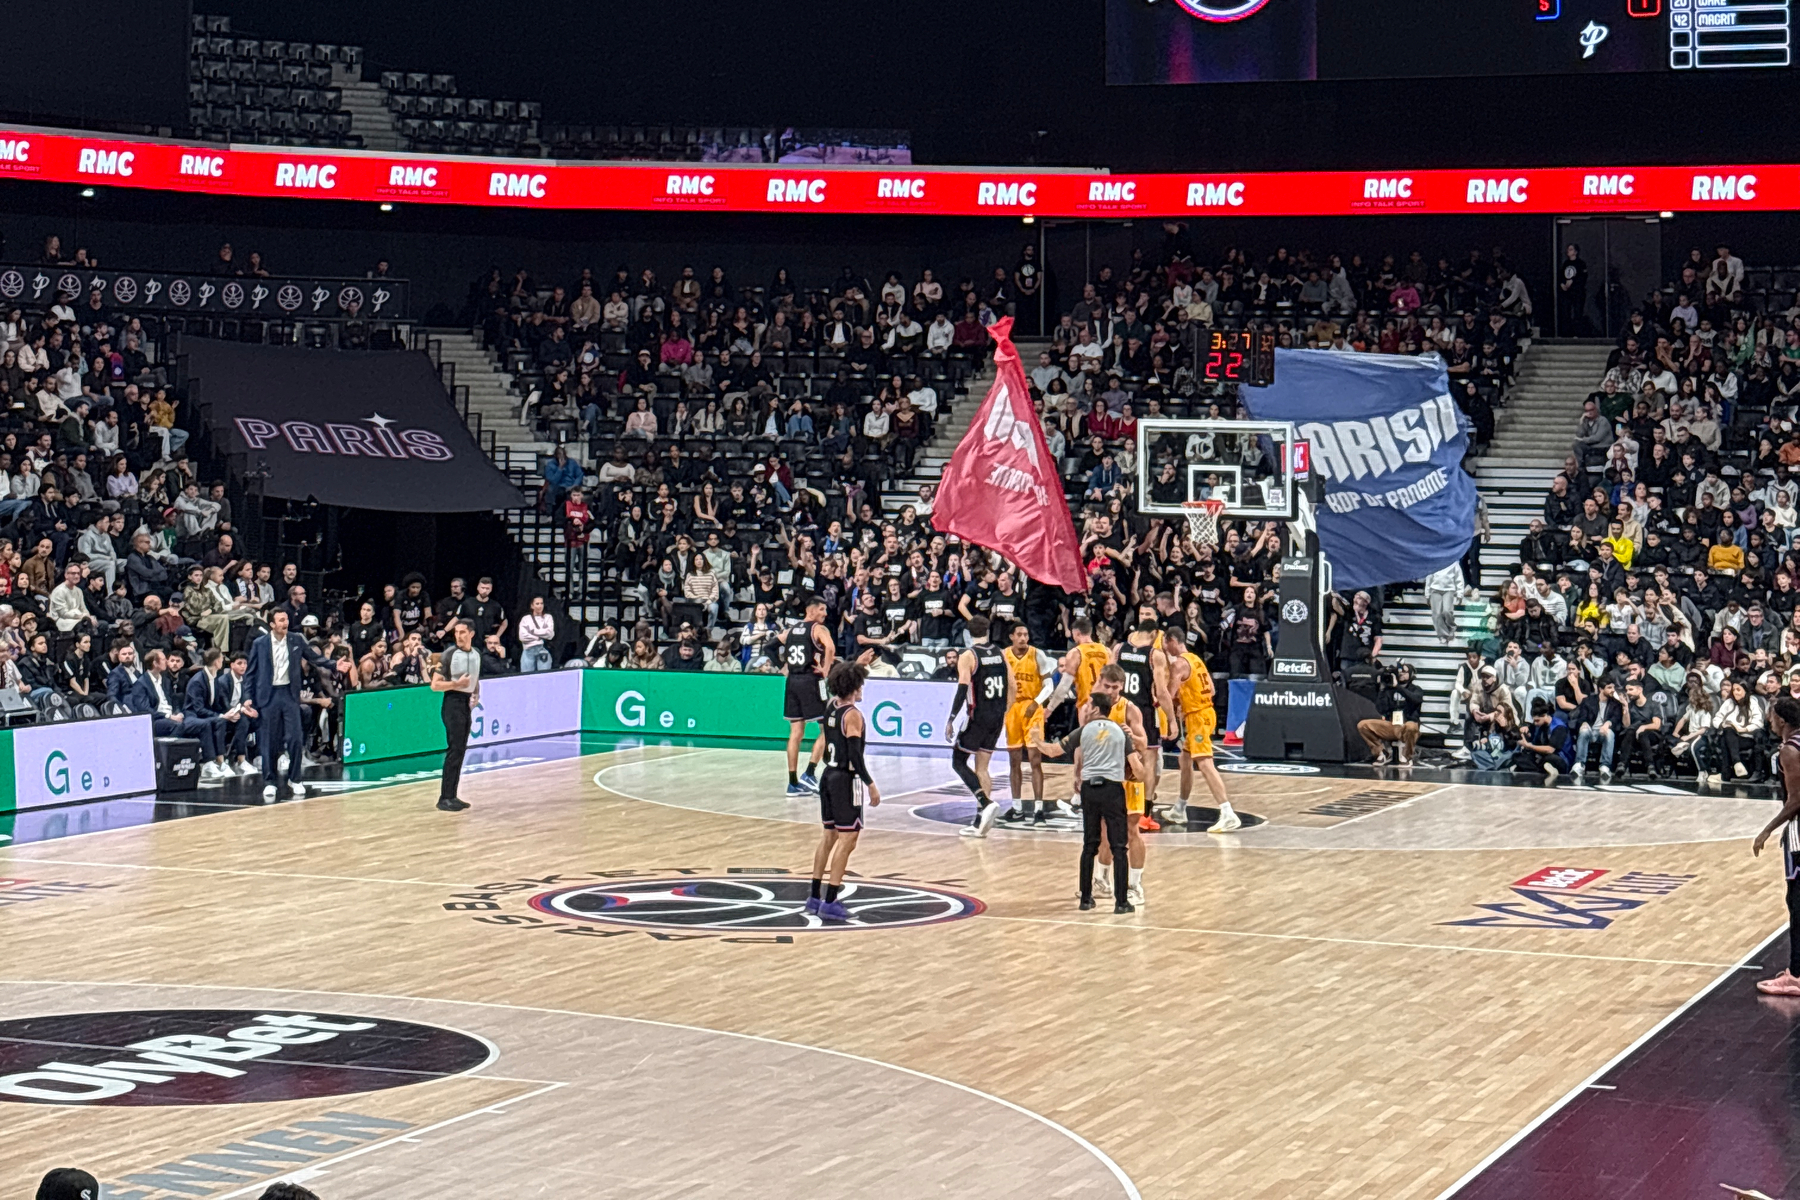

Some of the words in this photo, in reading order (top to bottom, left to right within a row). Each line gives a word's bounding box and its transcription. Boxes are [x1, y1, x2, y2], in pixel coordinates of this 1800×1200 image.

[1674, 14, 1687, 27] 42
[1698, 12, 1737, 26] MAGRIT
[0, 139, 30, 161] MC
[78, 147, 135, 177] RMC
[180, 154, 224, 177] RMC
[275, 162, 337, 189] RMC
[389, 165, 438, 188] RMC
[488, 172, 548, 198] RMC
[666, 174, 715, 195] RMC
[1583, 175, 1635, 196] RMC
[767, 178, 827, 203] RMC
[877, 178, 926, 199] RMC
[977, 182, 1037, 207] RMC
[1089, 181, 1137, 202] RMC
[1186, 182, 1245, 207] RMC
[1363, 177, 1413, 199] RMC
[1466, 177, 1529, 203] RMC
[1691, 175, 1757, 200] RMC
[1210, 332, 1250, 350] 3:27
[1205, 352, 1243, 378] 22
[234, 417, 454, 461] PARIS
[1325, 491, 1362, 514] KOP
[1385, 466, 1450, 510] PANAME
[787, 645, 806, 666] 35
[1276, 661, 1313, 675] Betclic
[984, 676, 1004, 699] 34
[1123, 672, 1140, 695] 18
